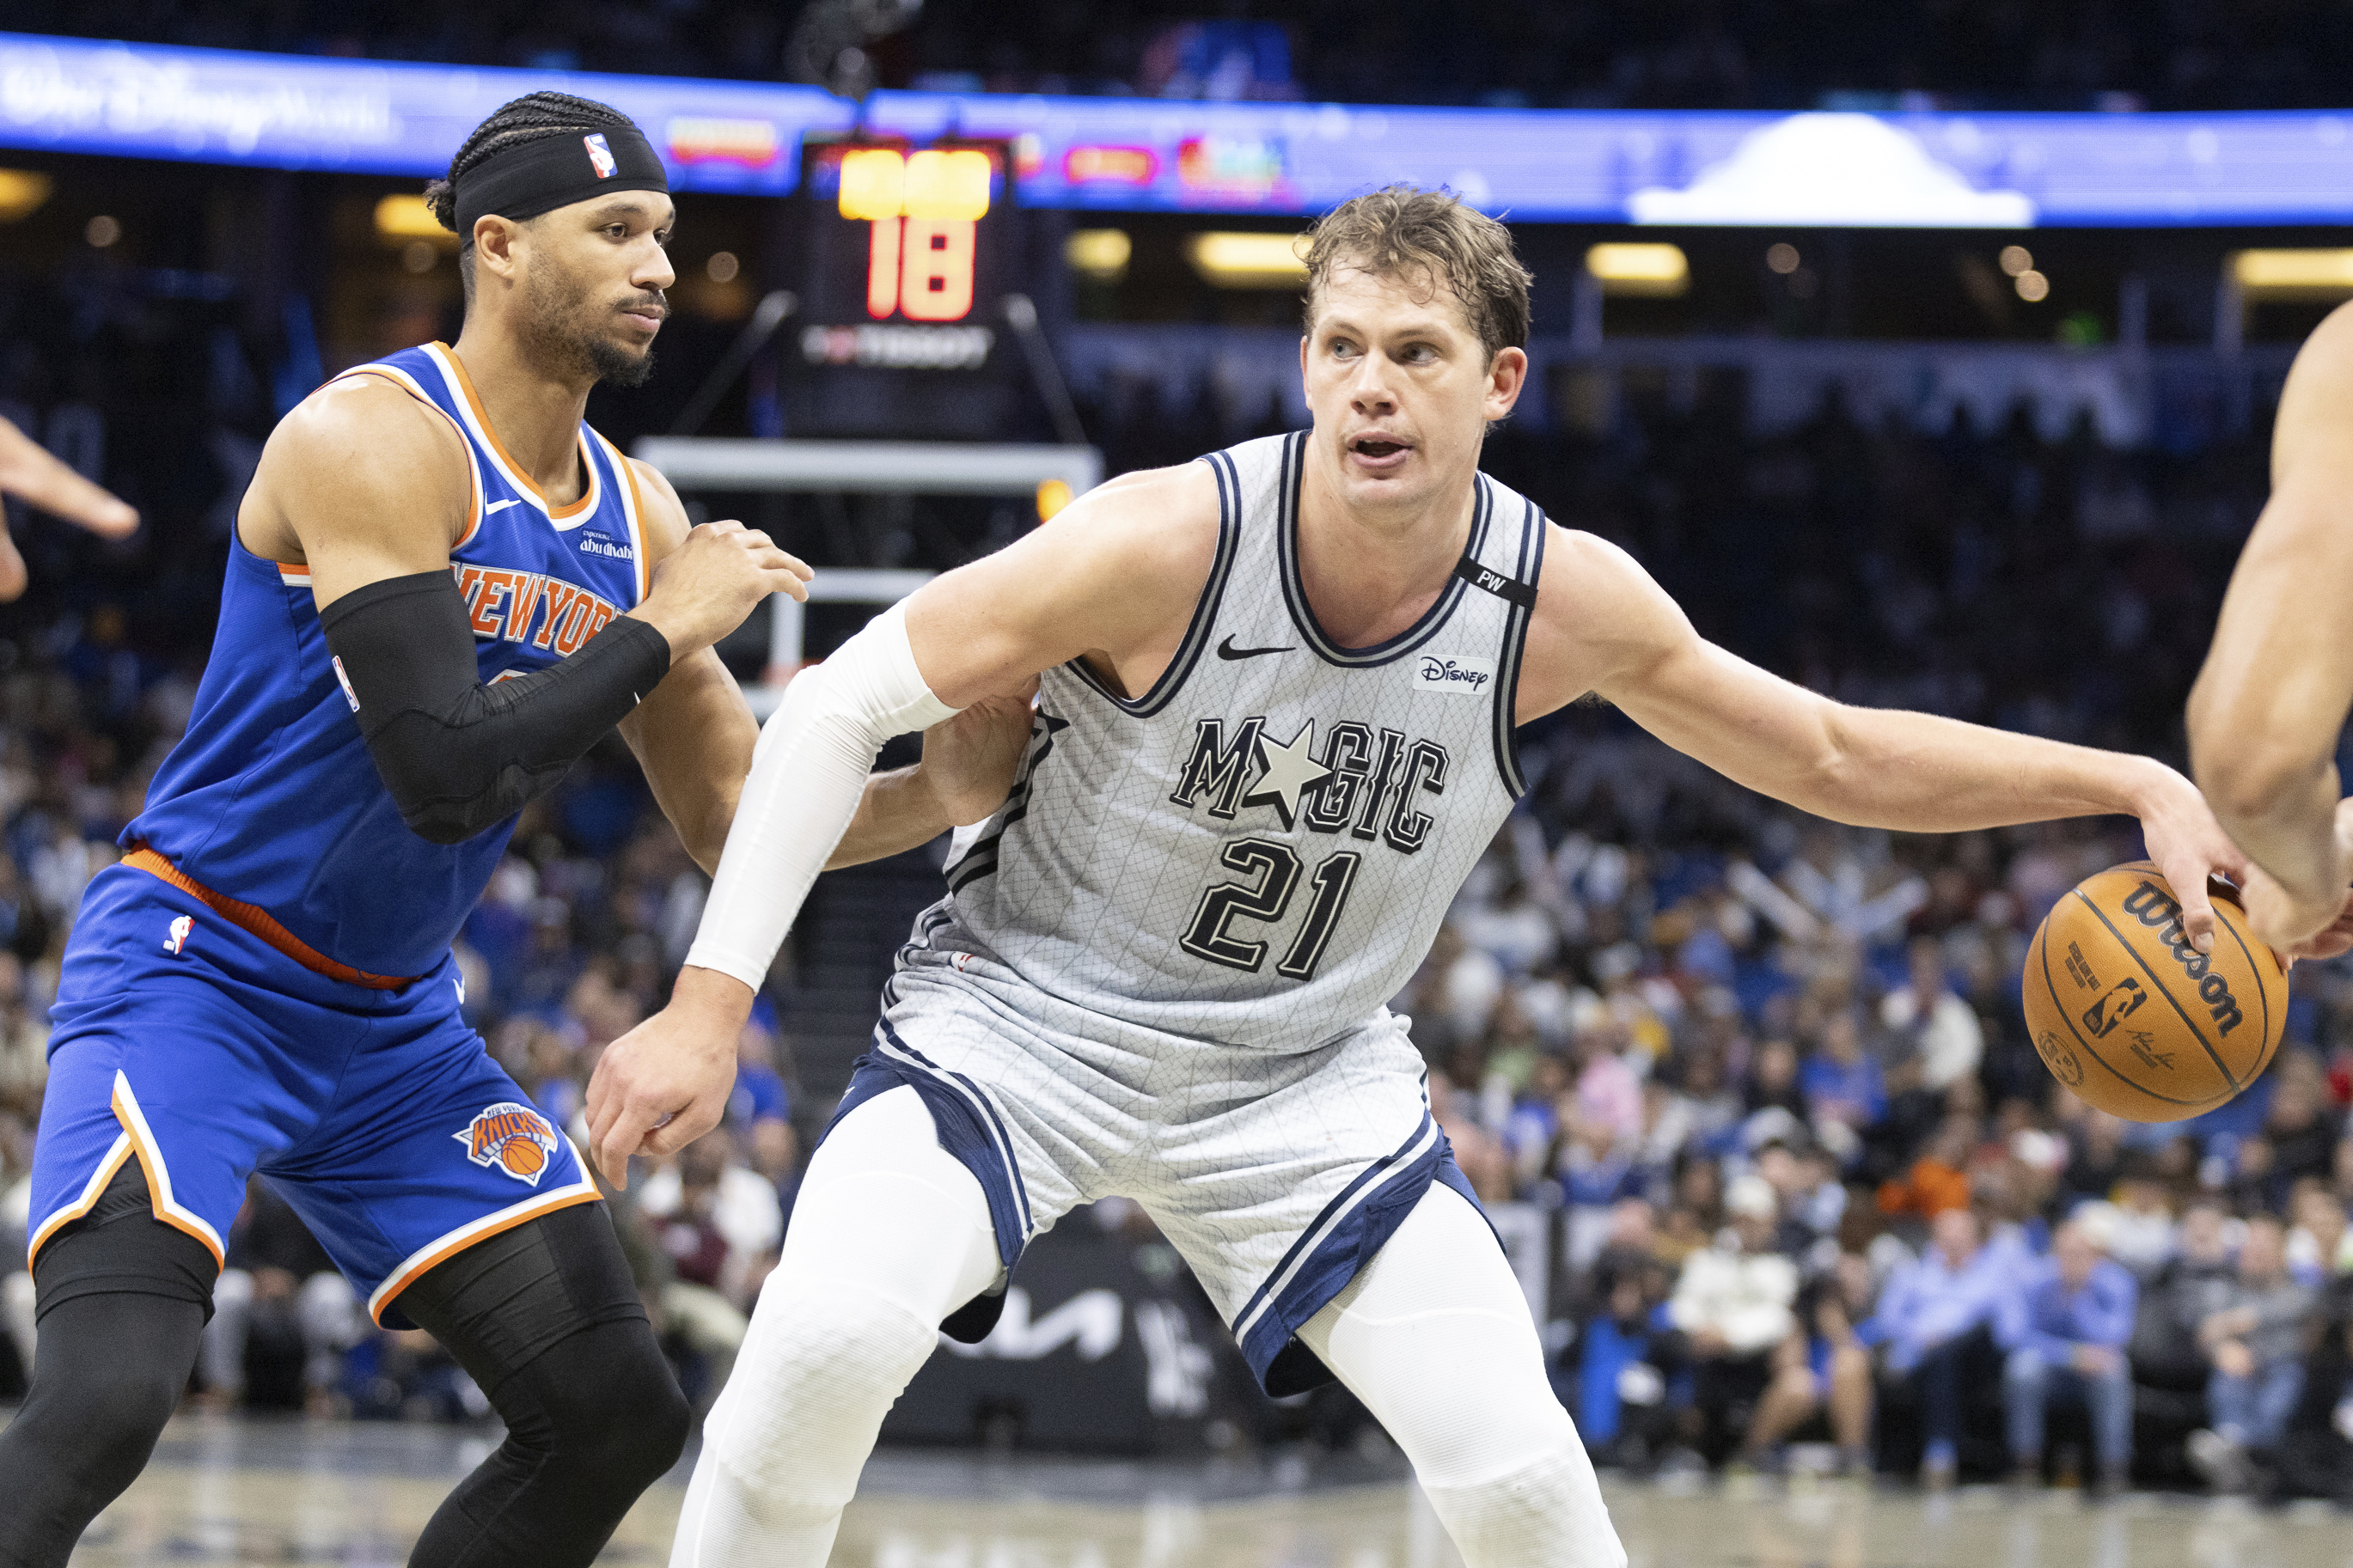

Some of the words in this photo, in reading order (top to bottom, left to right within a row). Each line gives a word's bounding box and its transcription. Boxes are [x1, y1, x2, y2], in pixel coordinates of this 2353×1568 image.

[866, 213, 977, 321] 18
[580, 539, 602, 554] abu
[603, 542, 633, 560] dhabi
[1476, 570, 1507, 592] PW
[532, 575, 626, 657] YOR
[1169, 716, 1450, 855] MGIC
[1179, 837, 1361, 981] 21
[473, 1111, 556, 1157] KNICKS
[487, 1106, 502, 1118] NEW
